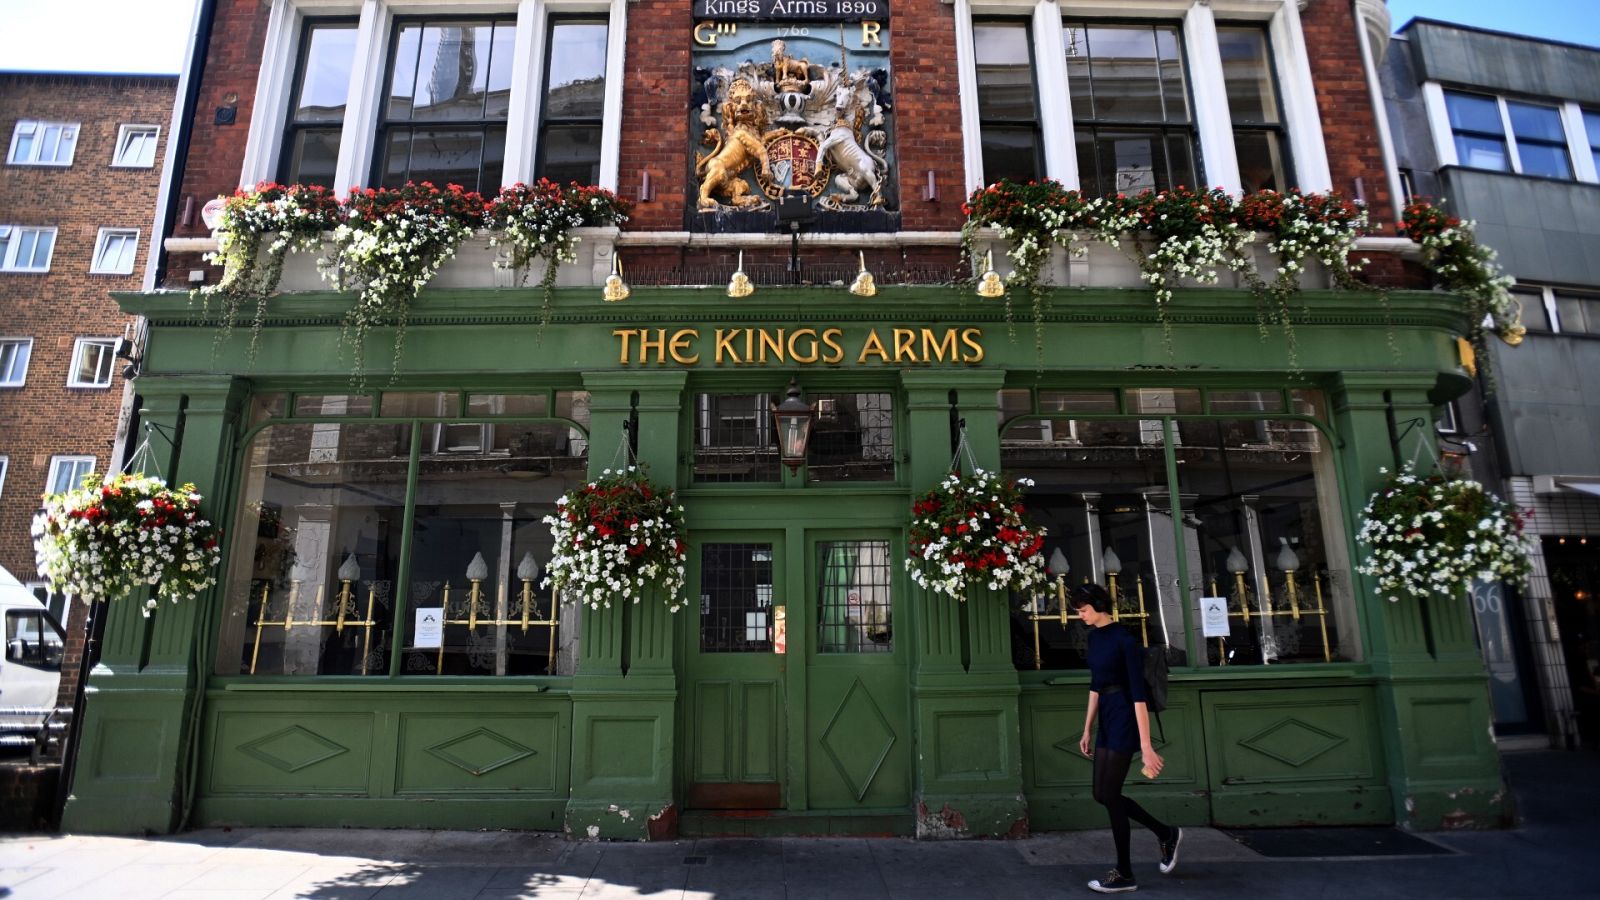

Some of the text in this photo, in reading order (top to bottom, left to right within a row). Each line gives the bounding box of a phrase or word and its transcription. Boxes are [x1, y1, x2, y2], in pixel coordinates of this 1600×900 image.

[770, 0, 828, 14] Arms
[836, 1, 877, 14] 1890
[777, 24, 809, 37] 1760
[861, 20, 882, 47] R
[612, 328, 985, 364] THE KINGS ARMS
[1473, 585, 1501, 613] 66
